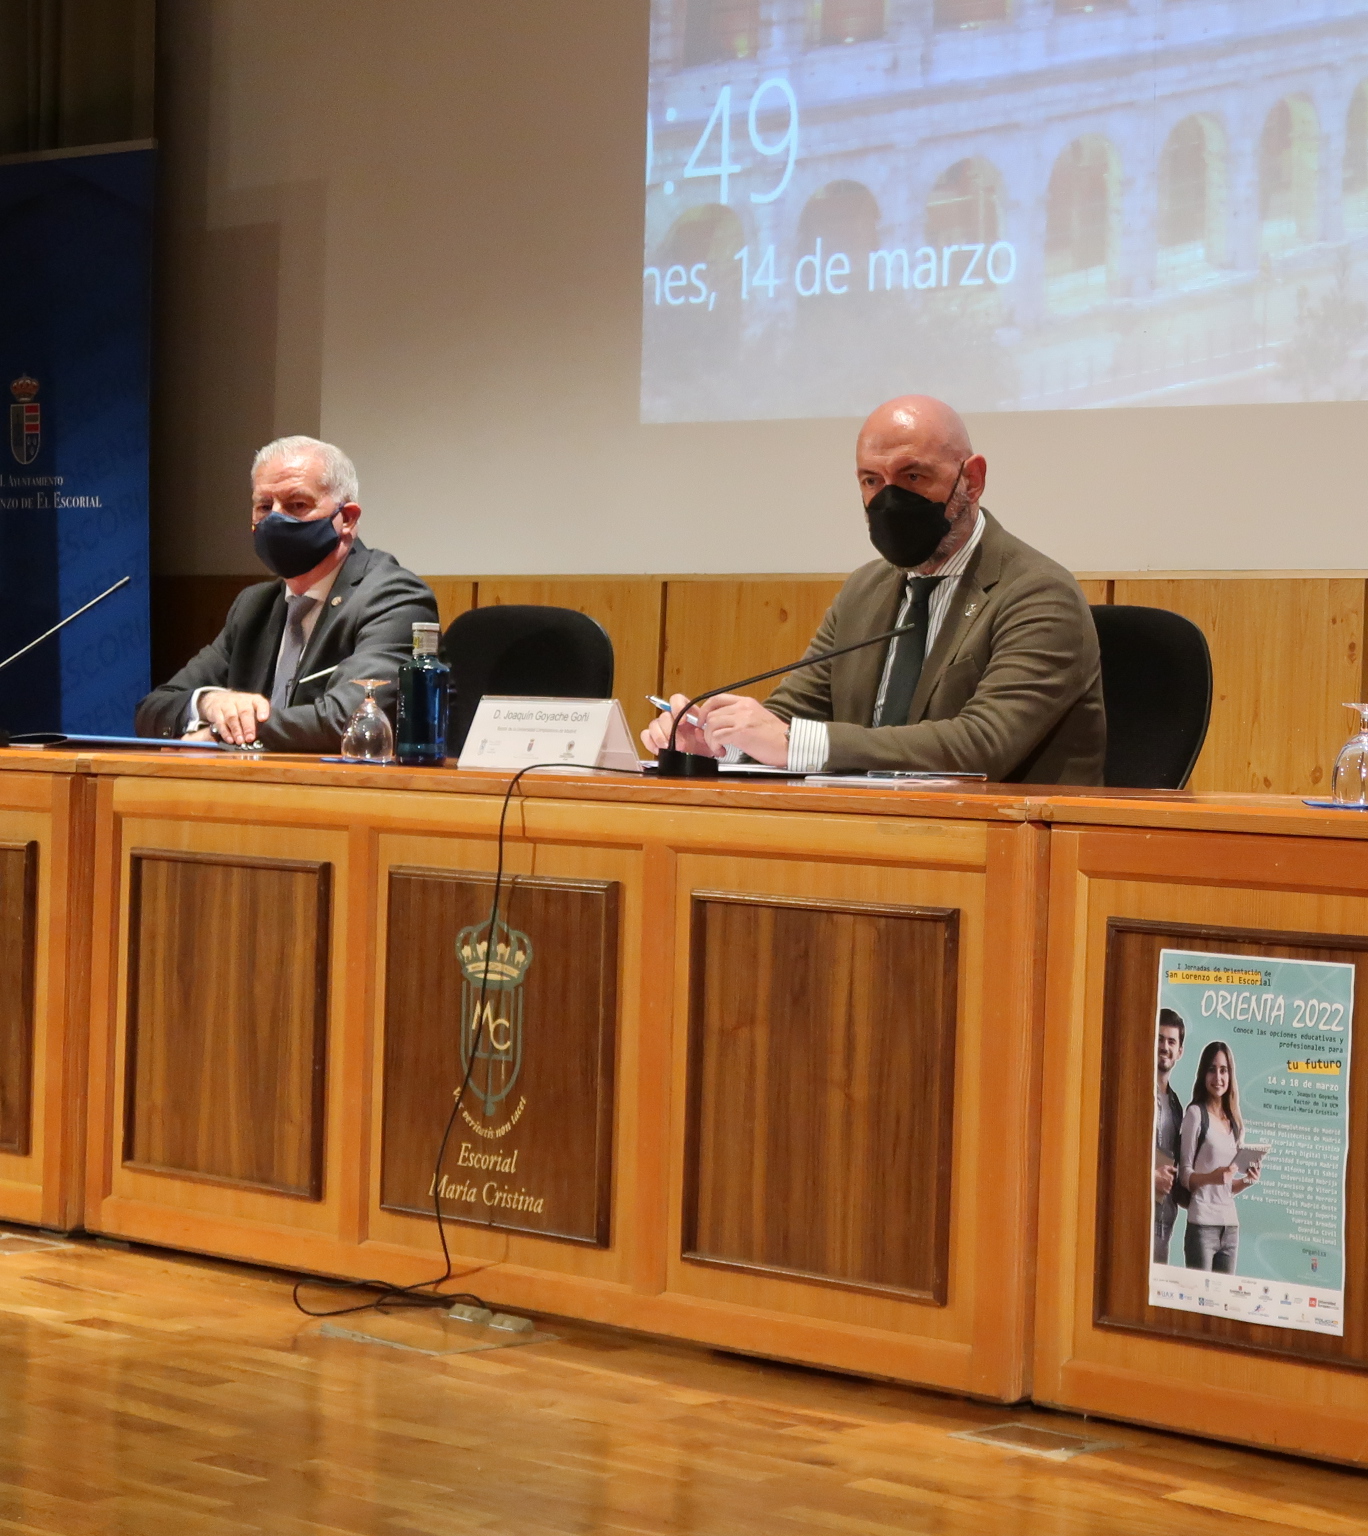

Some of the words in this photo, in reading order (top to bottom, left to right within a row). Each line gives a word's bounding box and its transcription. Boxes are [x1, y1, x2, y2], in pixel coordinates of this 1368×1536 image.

[646, 78, 799, 205] :49
[734, 245, 779, 300] 14
[794, 237, 850, 297] de
[868, 240, 1017, 292] marzo
[53, 491, 102, 509] ESCORIAL
[504, 710, 533, 722] Joaquín
[535, 711, 569, 723] Goyache
[571, 711, 590, 722] Goñi
[1184, 963, 1210, 971] Jornadas
[1223, 967, 1261, 976] Orientación
[1165, 970, 1178, 979] San
[1181, 972, 1210, 982] Lorenzo
[1213, 975, 1222, 983] de
[1226, 975, 1234, 984] El
[1238, 977, 1271, 986] Escorial
[1200, 989, 1285, 1026] ORIENTA
[1292, 998, 1345, 1032] 2022
[1232, 1026, 1254, 1035] Conoce
[1269, 1031, 1297, 1039] opciones
[1300, 1034, 1336, 1042] educativas
[1279, 1041, 1325, 1052] profesionales
[1286, 1059, 1299, 1070] tu
[1305, 1058, 1342, 1070] futuro
[1267, 1076, 1277, 1085] 14
[1280, 1078, 1286, 1086] a
[1289, 1078, 1299, 1087] 18
[1302, 1079, 1312, 1089] de
[1315, 1082, 1339, 1091] marzo
[457, 1142, 518, 1174] Escorial
[428, 1173, 477, 1203] María
[482, 1181, 544, 1214] Cristina
